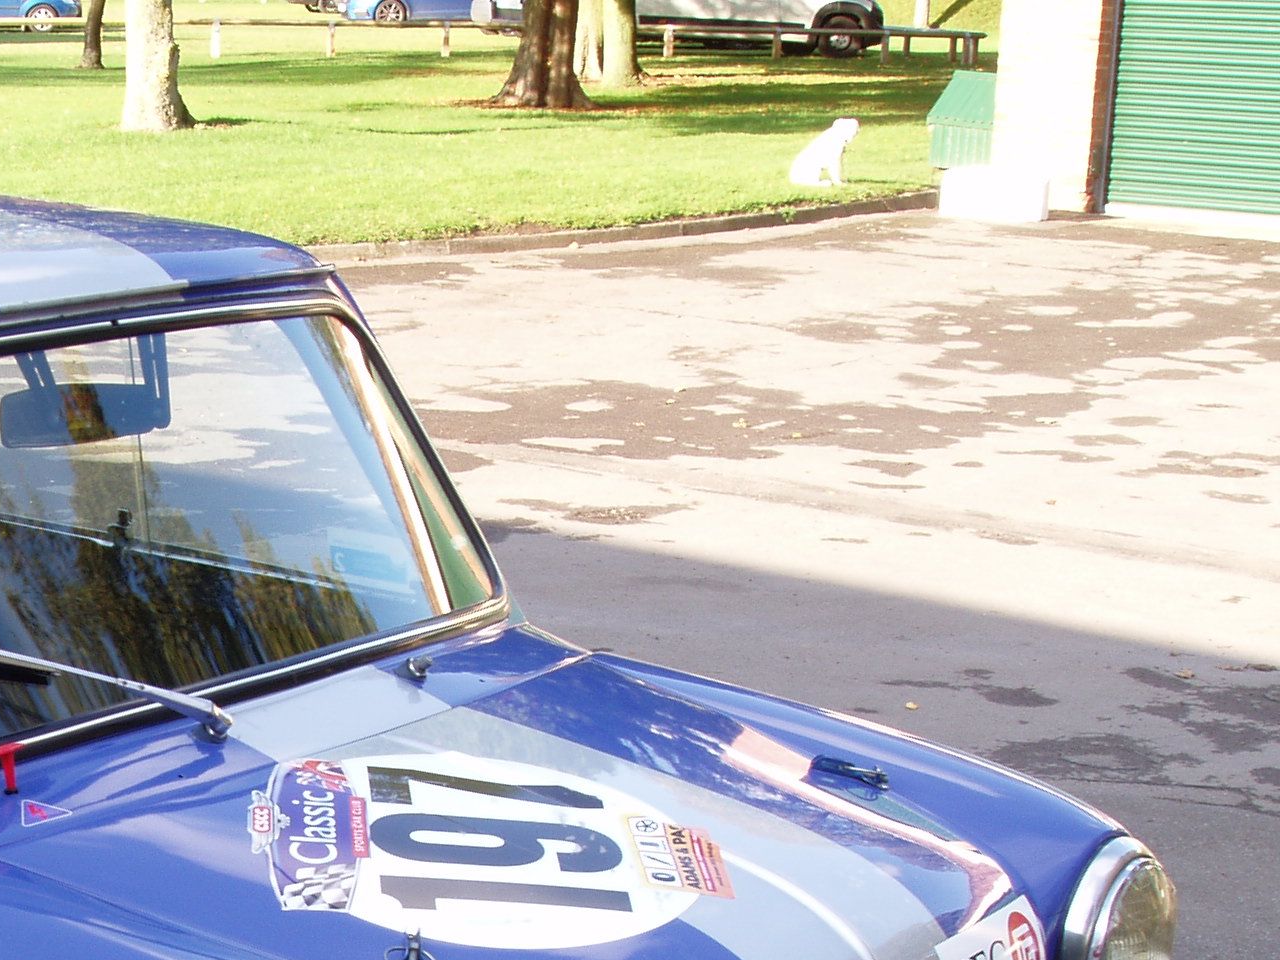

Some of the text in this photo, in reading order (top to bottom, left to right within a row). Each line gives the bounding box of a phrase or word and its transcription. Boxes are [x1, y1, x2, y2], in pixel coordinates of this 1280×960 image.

[252, 806, 271, 833] CSCC
[288, 789, 338, 865] Classic
[351, 800, 365, 852] SPORTS CAR CLUB
[366, 765, 634, 913] 197
[678, 856, 702, 889] ADAMS
